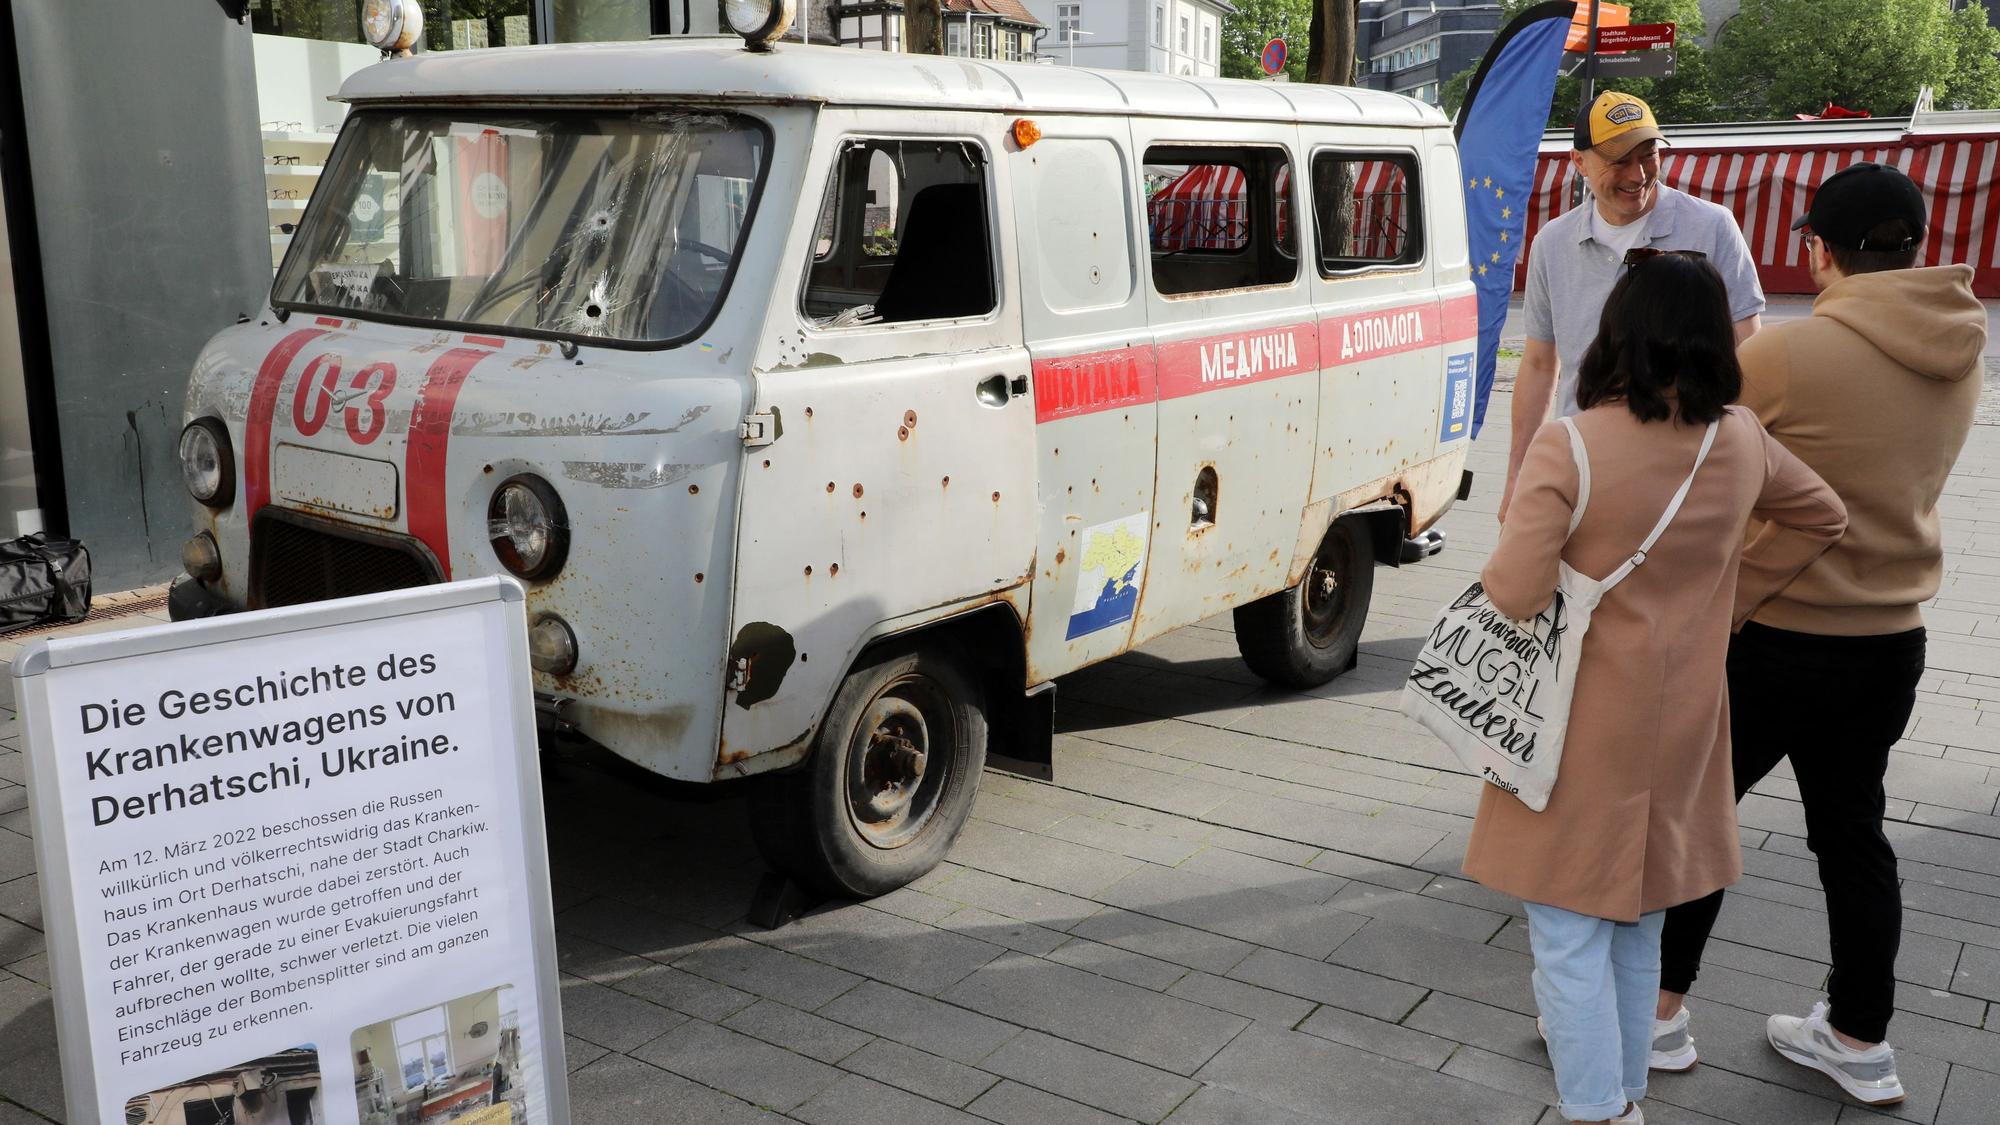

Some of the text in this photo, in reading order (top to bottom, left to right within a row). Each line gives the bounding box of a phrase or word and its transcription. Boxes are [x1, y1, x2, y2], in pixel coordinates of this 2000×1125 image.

[1200, 331, 1298, 383] МЕДИЧНА
[1340, 311, 1423, 359] ДОПОМОГА
[293, 353, 397, 445] 03
[79, 653, 437, 735] Die Geschichte des
[85, 691, 456, 781] Krankenwagens von
[1408, 659, 1538, 764] Zauberer
[91, 734, 459, 827] Derhatschi, Ukraine.
[1490, 770, 1520, 796] Thalia
[98, 788, 443, 876] Am 12. März 2022 beschossen die Russen
[100, 803, 480, 899] willkürlich und völkerrechtswidrig das Kranken-
[103, 821, 489, 924] haus im Ort Derhatschi, nahe der Stadt Charkiw.
[106, 845, 470, 947] Das Krankenhaus wurde dabei zerstört. Auch
[109, 870, 463, 971] der Krankenwagen wurde getroffen und der
[112, 887, 479, 996] Fahrer, der gerade zu einer Evakuierungsfahrt
[115, 910, 478, 1019] aufbrechen wollte, schwer verletzt. Die vielen
[117, 928, 489, 1042] Einschläge der Bombensplitter sind am ganzen
[120, 1001, 313, 1066] Fahrzeug zu erkennen.
